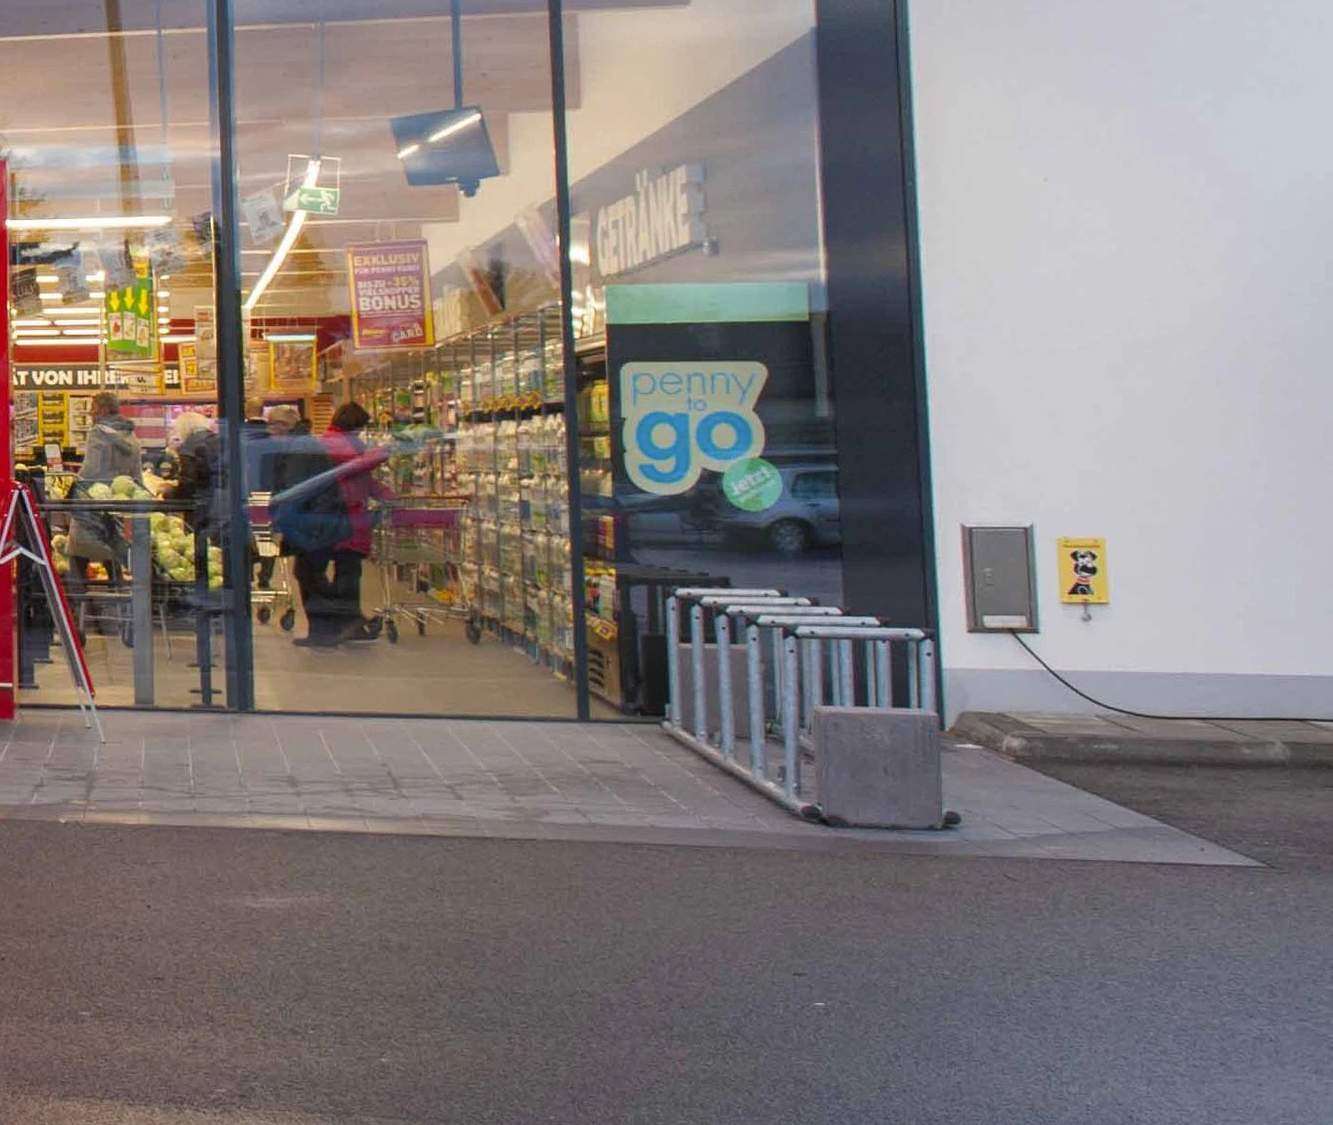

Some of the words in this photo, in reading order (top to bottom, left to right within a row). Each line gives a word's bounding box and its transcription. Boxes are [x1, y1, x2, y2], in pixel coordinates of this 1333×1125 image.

[596, 164, 691, 277] GETRÄNKE
[359, 294, 422, 311] BONUS
[32, 370, 73, 386] VON
[631, 371, 758, 407] penny
[686, 395, 708, 411] to
[636, 411, 753, 483] go
